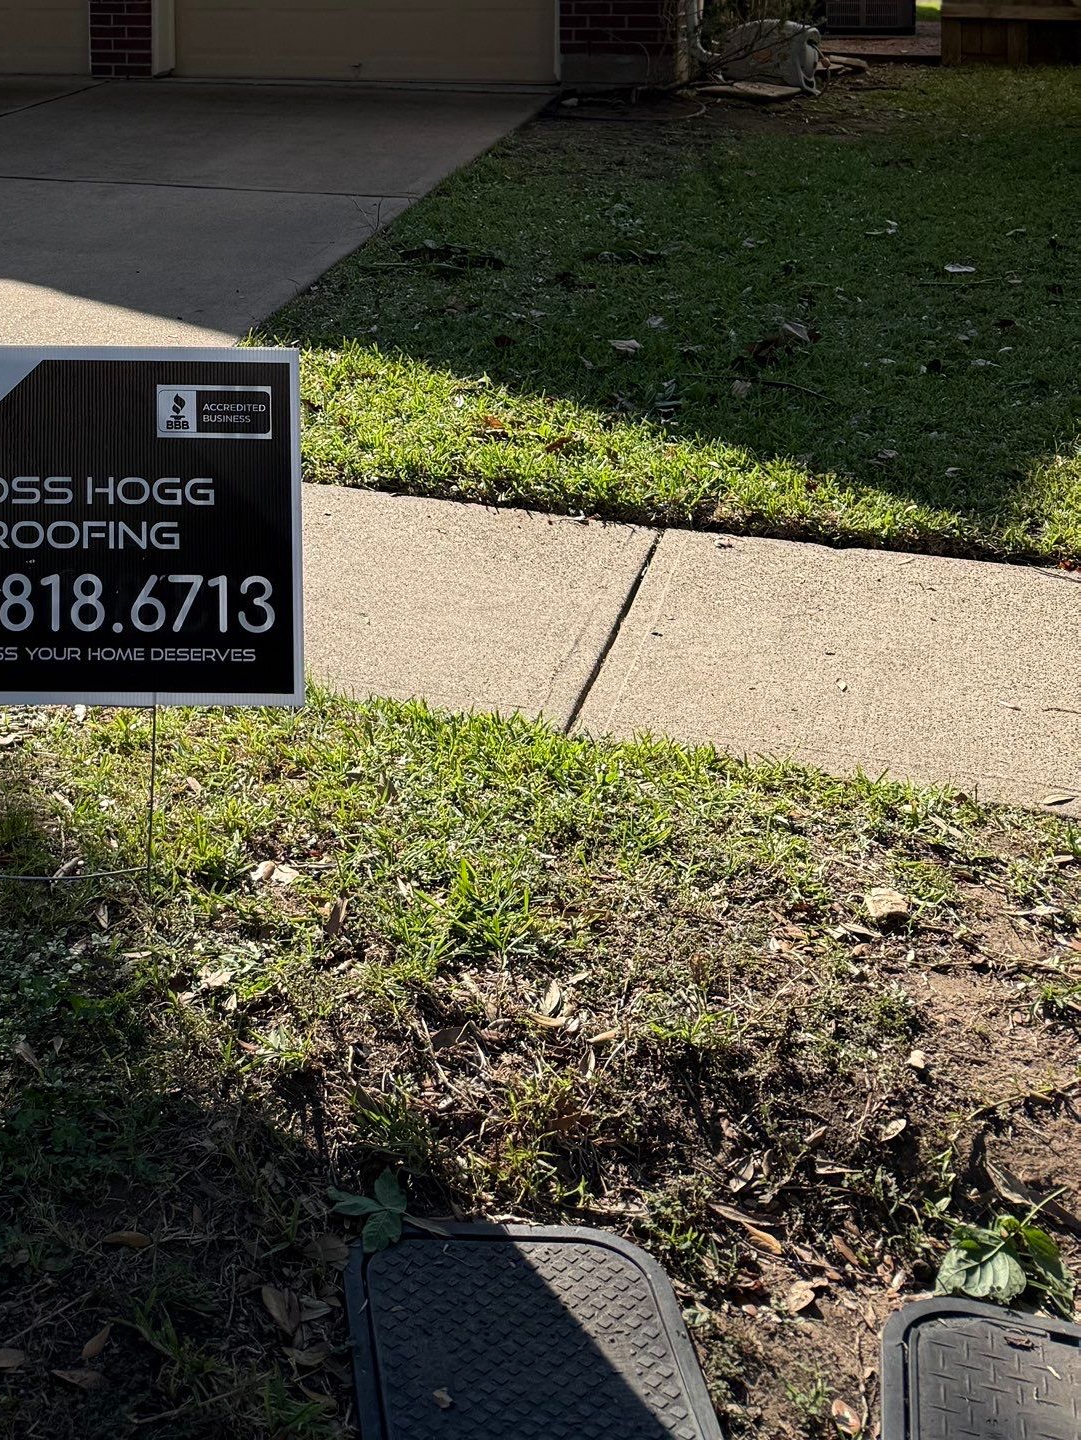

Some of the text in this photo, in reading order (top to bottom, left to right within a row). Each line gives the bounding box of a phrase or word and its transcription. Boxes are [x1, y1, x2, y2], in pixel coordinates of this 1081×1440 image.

[202, 403, 266, 412] ACCREDITED
[202, 414, 251, 423] BUSINESS
[166, 420, 189, 430] BBB
[87, 477, 215, 506] HOGG
[25, 647, 81, 661] YOUR
[88, 647, 145, 661] HOME
[150, 648, 256, 662] DESERVES
